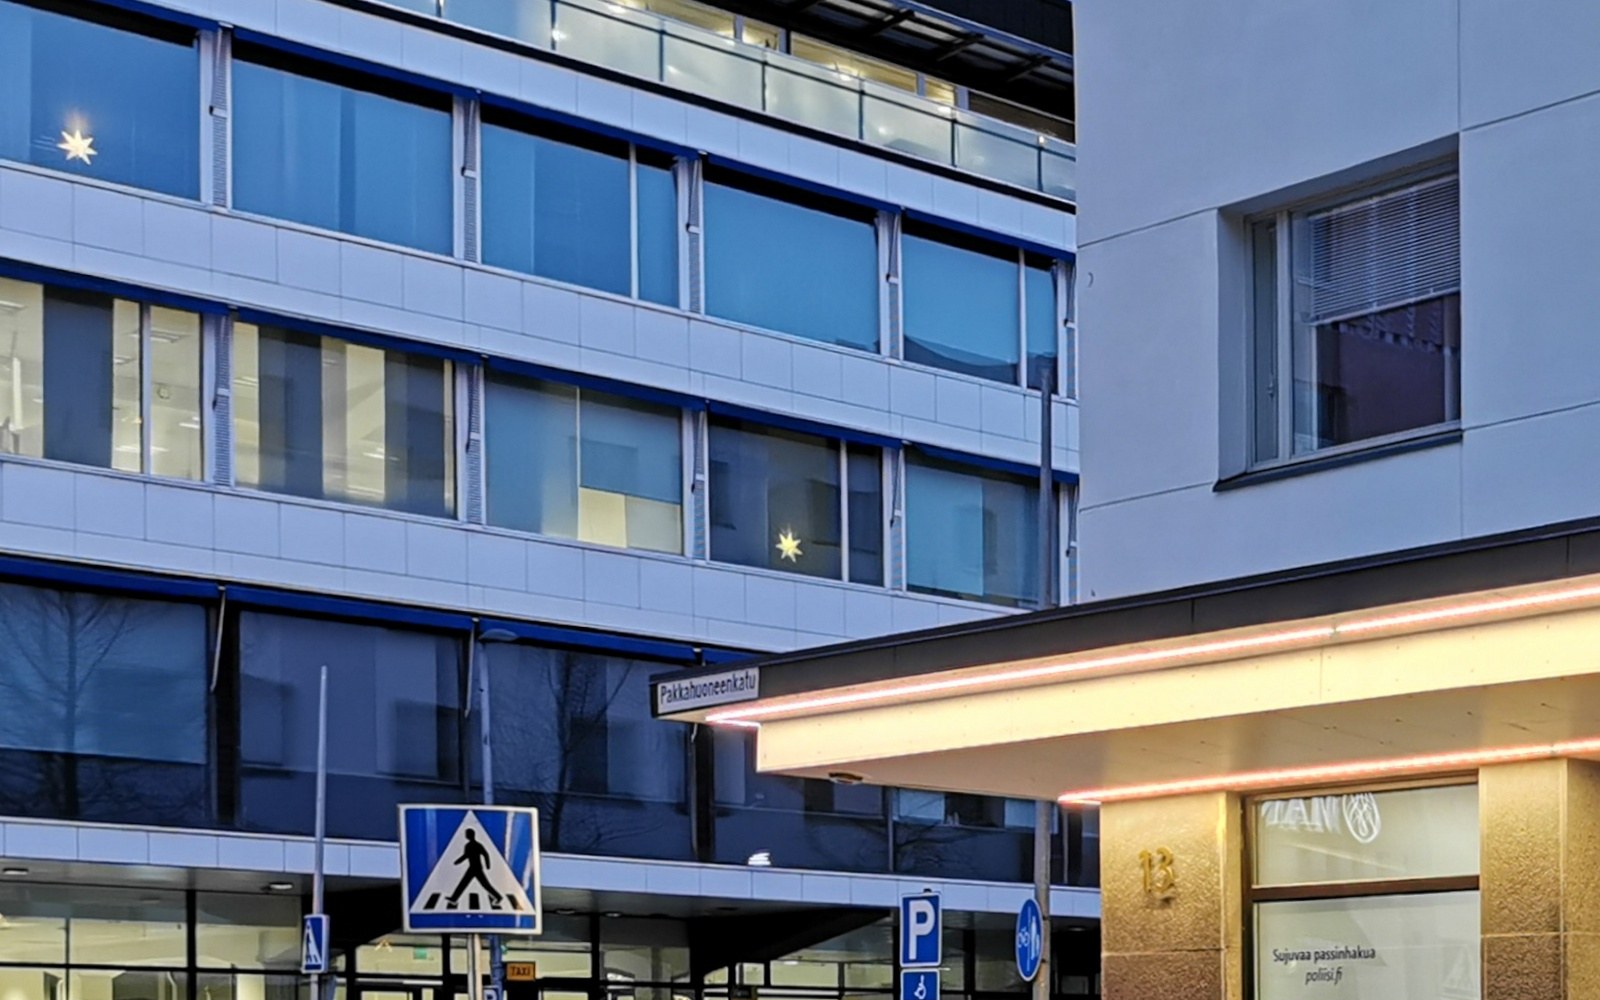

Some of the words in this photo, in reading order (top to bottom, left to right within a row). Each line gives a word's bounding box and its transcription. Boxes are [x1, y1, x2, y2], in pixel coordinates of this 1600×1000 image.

[660, 670, 756, 704] Pakkahuoneenkatu
[909, 899, 935, 960] P
[1272, 948, 1311, 966] Sujuvaa
[1314, 945, 1376, 964] passinhakua
[510, 966, 532, 977] TAXI
[1305, 966, 1343, 986] poliisi.fi
